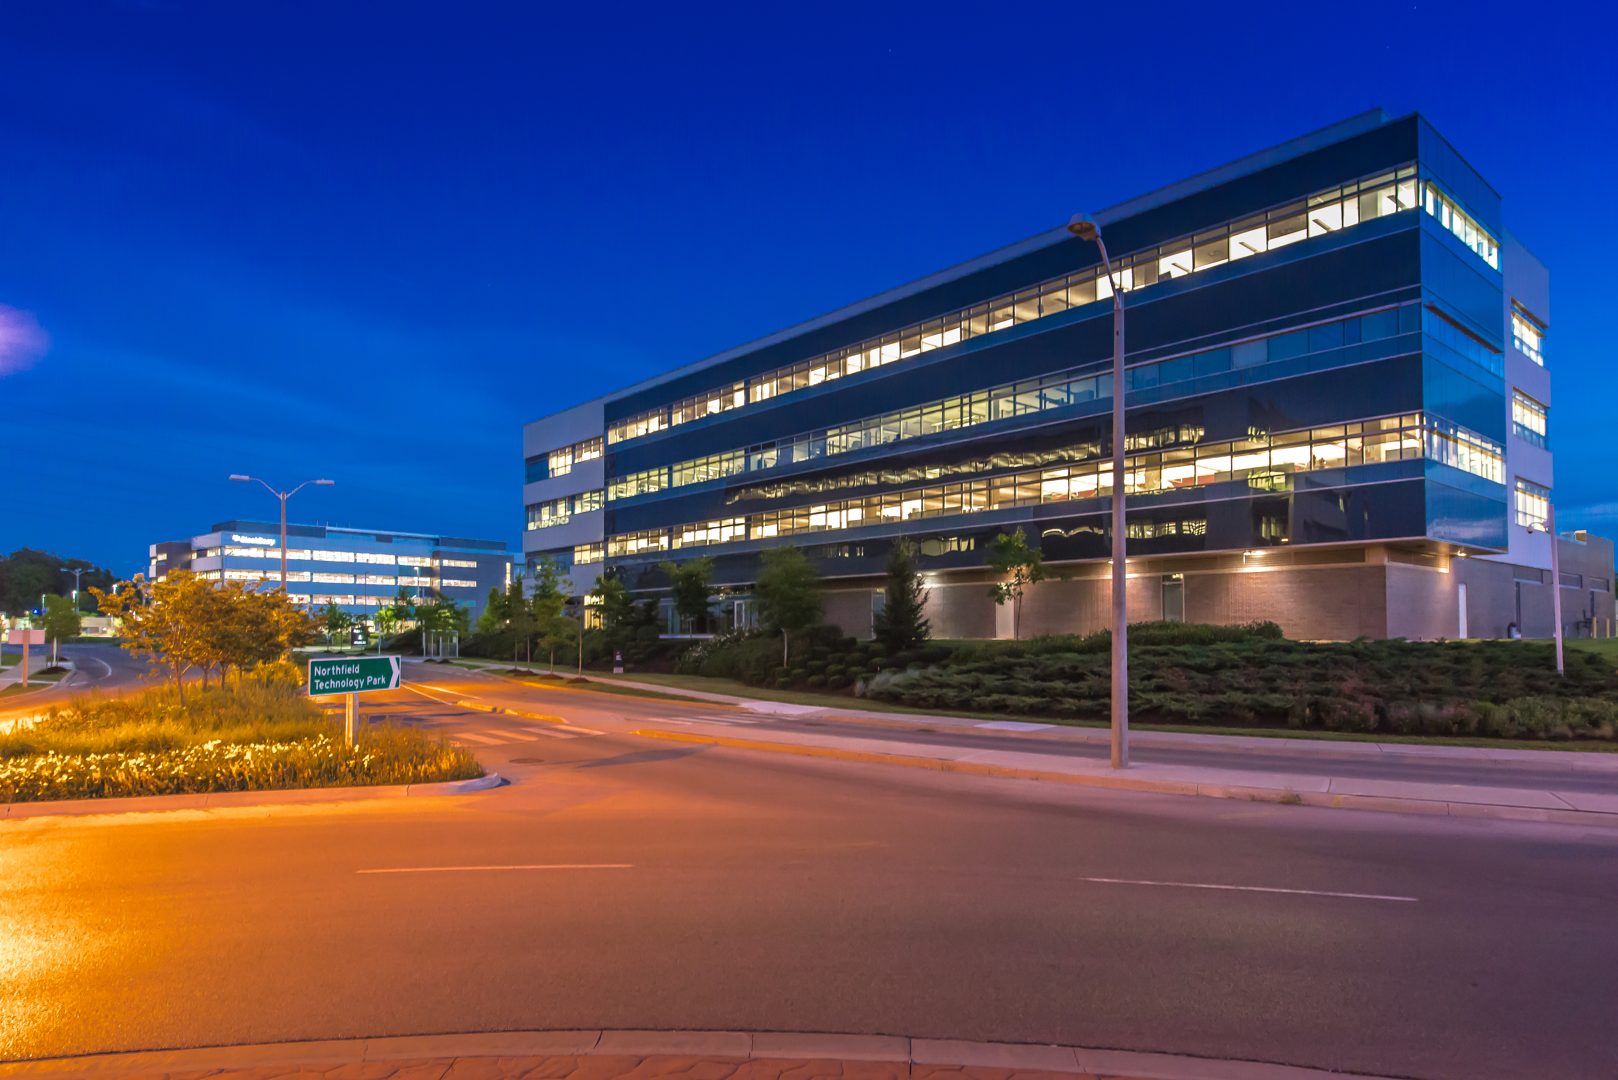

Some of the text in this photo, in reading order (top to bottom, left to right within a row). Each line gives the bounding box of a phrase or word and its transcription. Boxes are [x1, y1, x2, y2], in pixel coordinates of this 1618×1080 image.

[314, 664, 360, 676] Northfield
[314, 674, 386, 690] Technology Park
